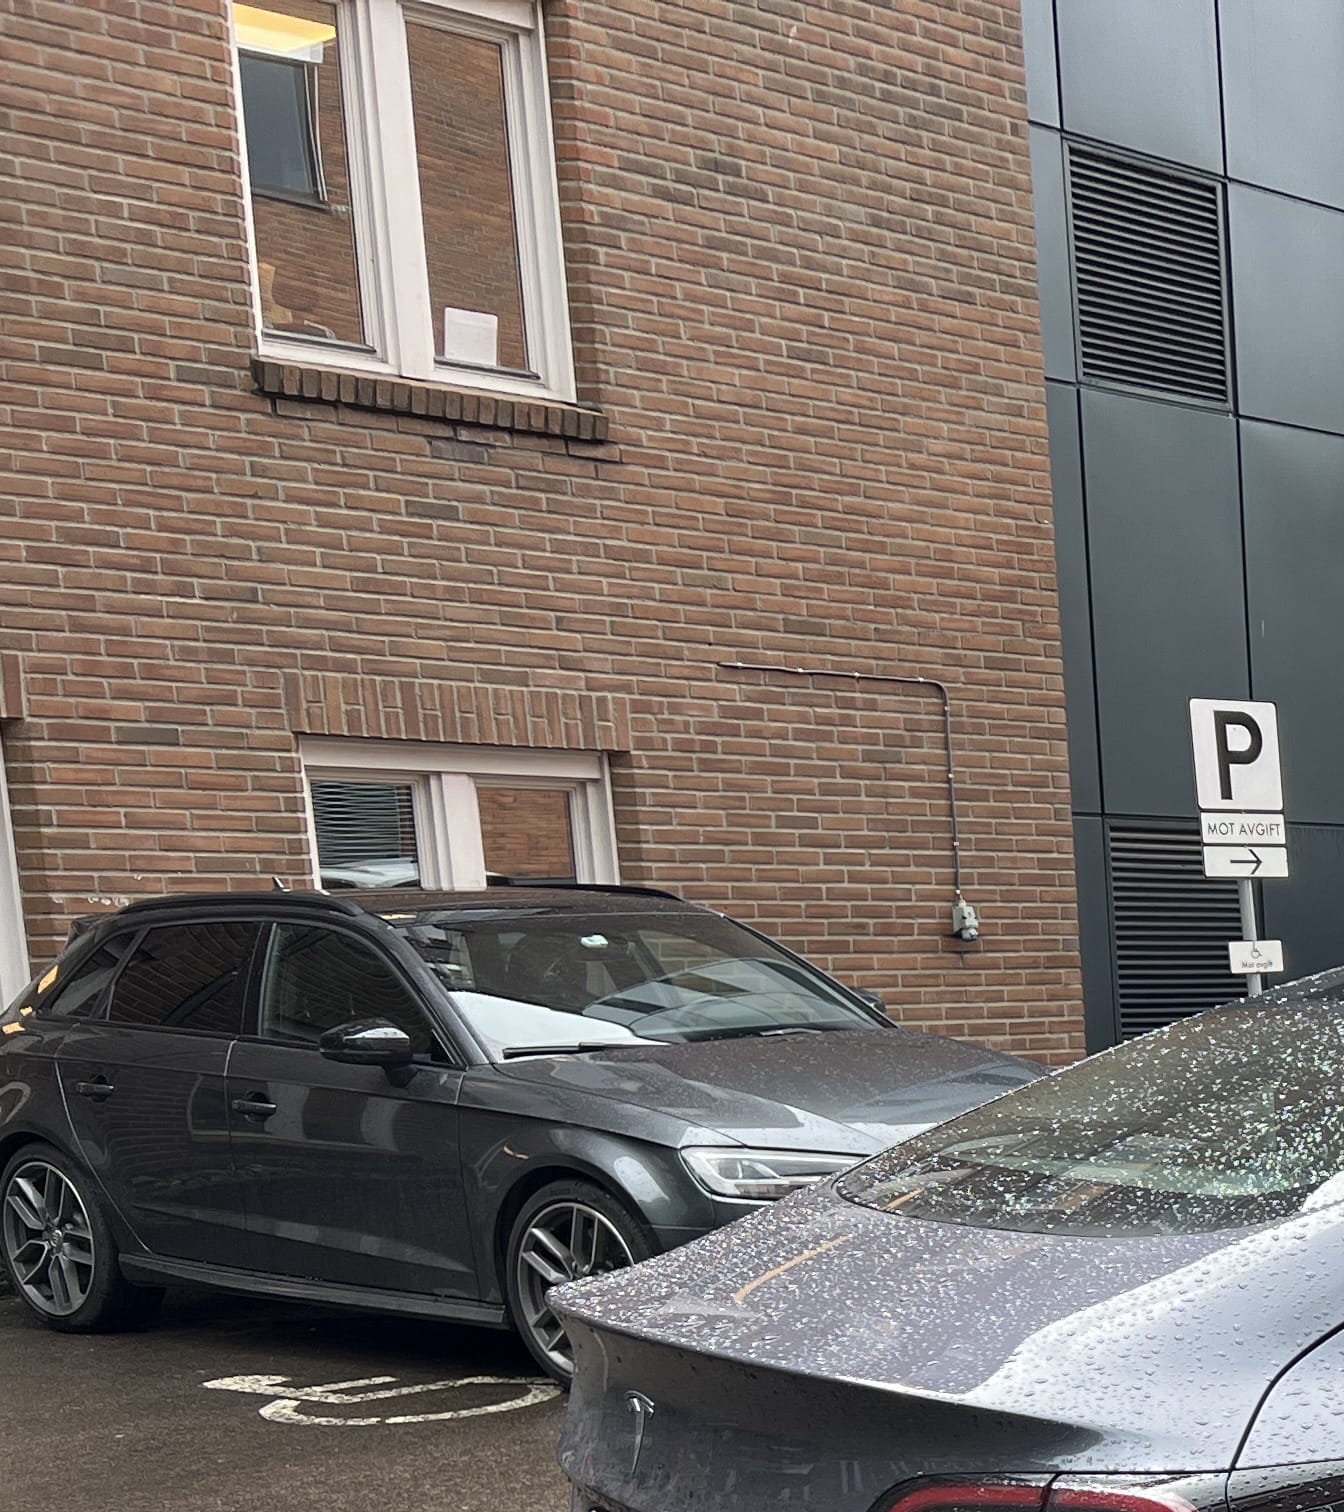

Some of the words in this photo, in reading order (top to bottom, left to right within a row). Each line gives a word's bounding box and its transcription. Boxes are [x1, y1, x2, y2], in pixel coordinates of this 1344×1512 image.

[1213, 710, 1262, 800] P
[1208, 822, 1235, 836] MOT
[1239, 822, 1280, 836] AVGIFT
